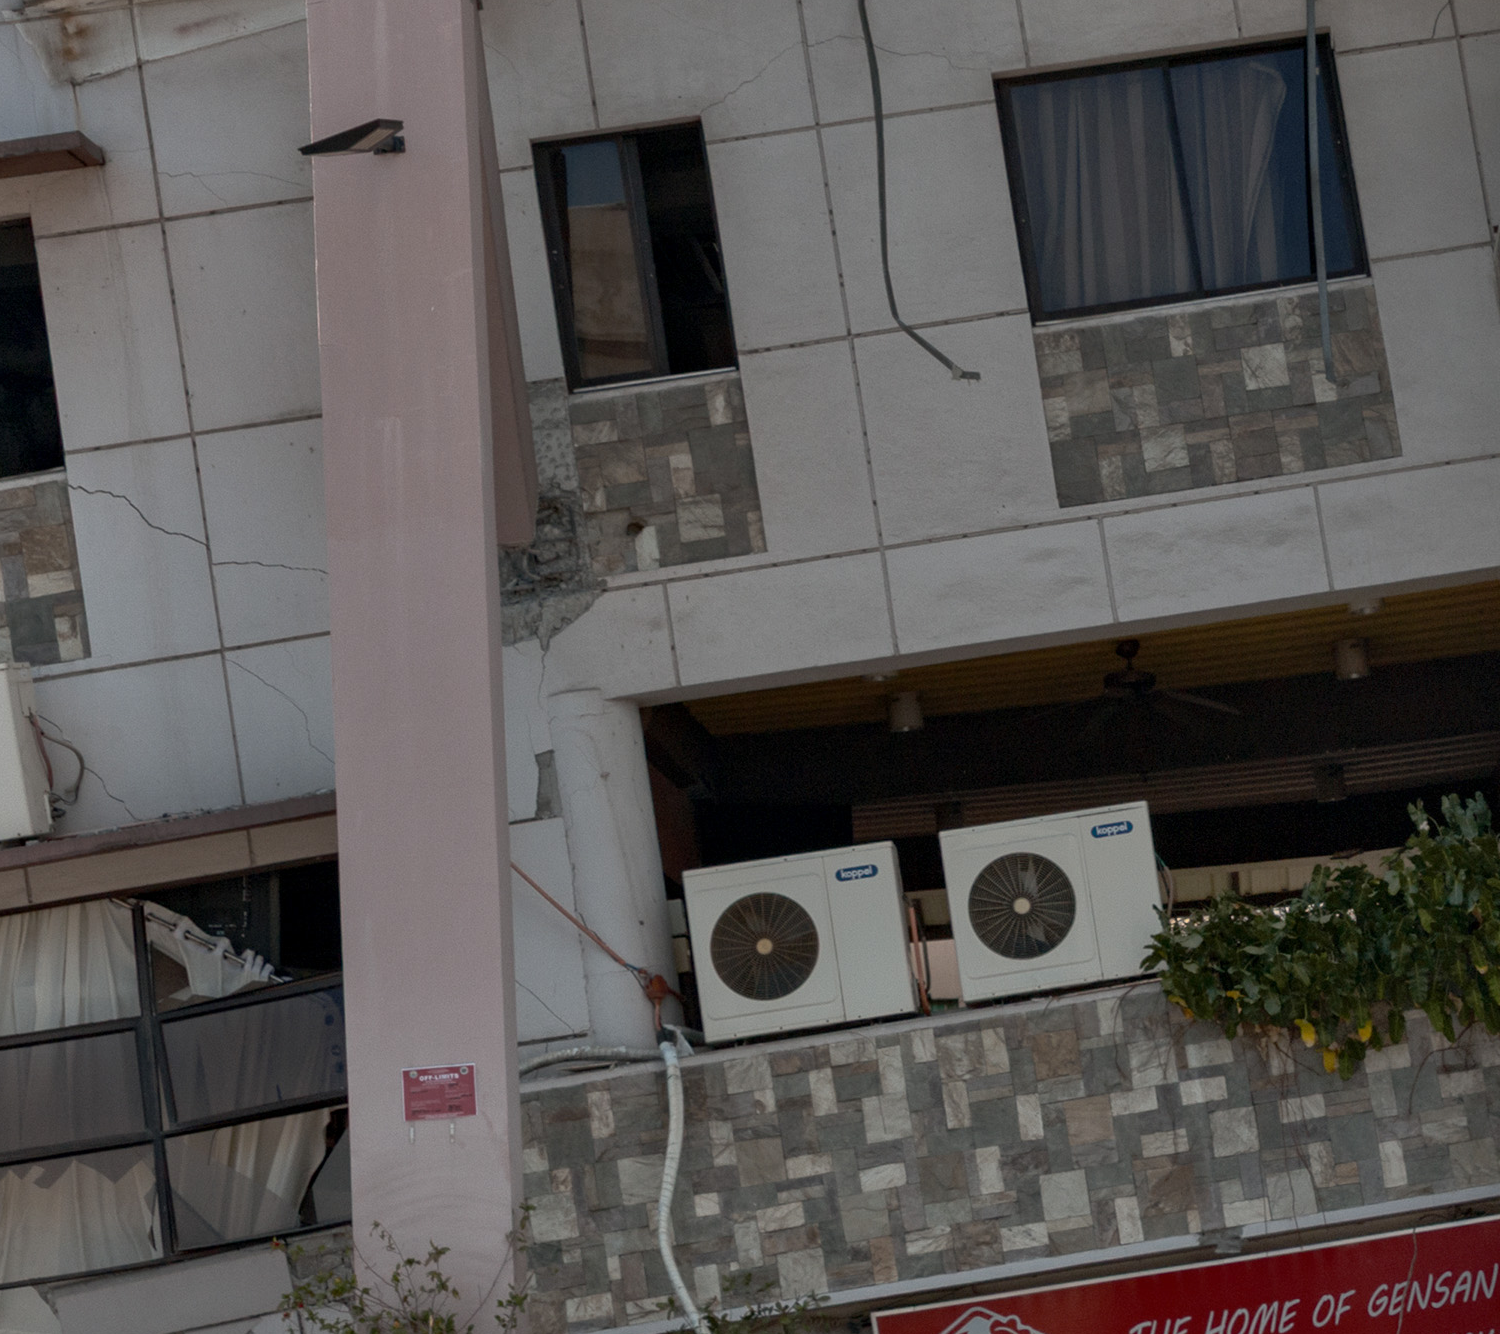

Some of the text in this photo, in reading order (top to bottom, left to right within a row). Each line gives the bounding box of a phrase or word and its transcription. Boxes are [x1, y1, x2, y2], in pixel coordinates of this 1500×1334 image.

[1095, 822, 1129, 838] koppel
[840, 865, 873, 881] koppel
[1312, 1289, 1357, 1328] OF
